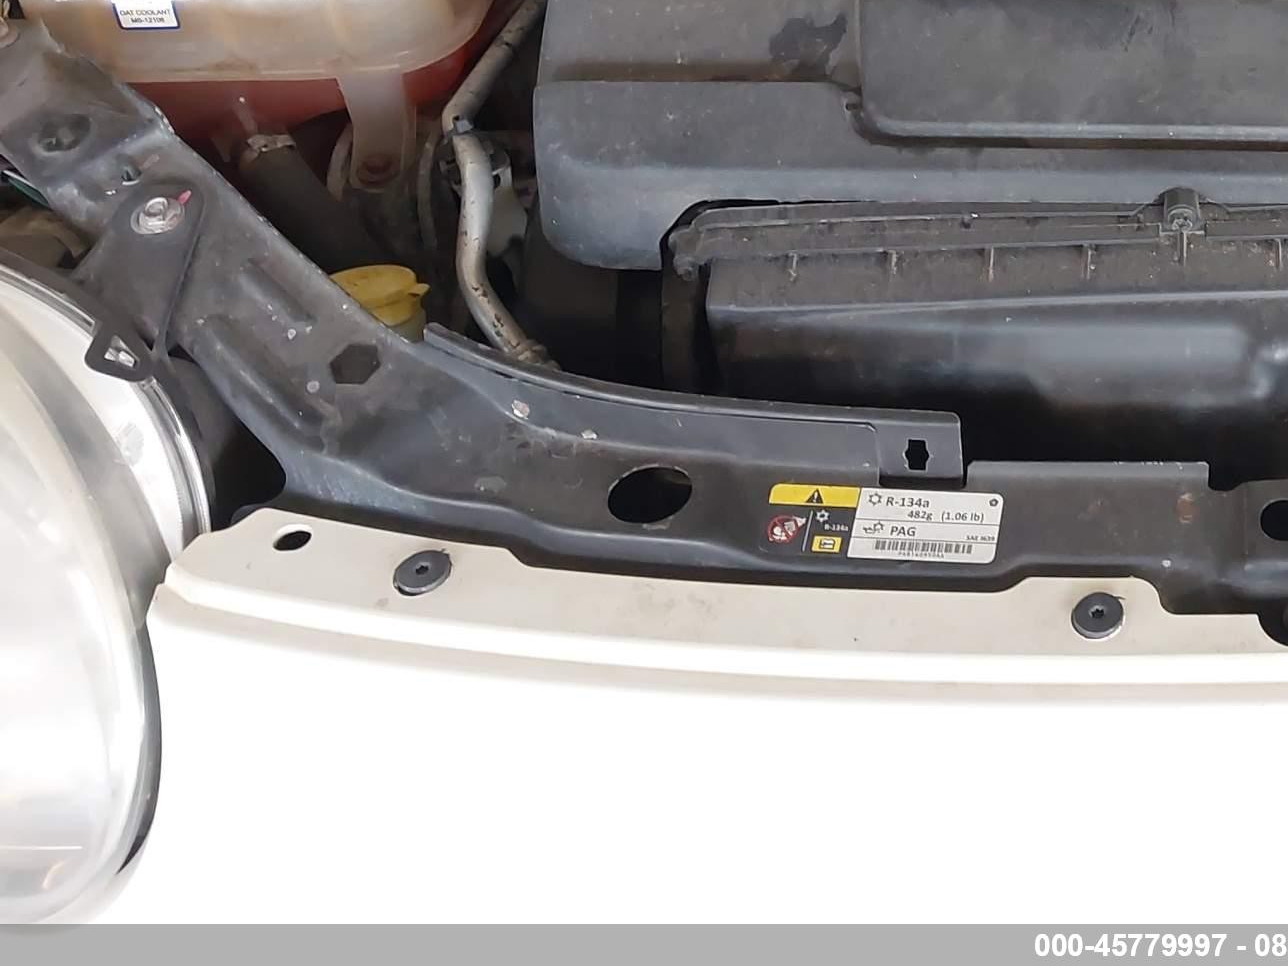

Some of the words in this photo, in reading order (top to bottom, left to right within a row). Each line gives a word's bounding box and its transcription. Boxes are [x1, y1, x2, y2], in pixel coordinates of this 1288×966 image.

[885, 497, 930, 509] R-134a
[907, 510, 933, 521] 482g
[941, 512, 968, 522] (1.06
[970, 512, 985, 523] lb)
[890, 526, 917, 537] PAG
